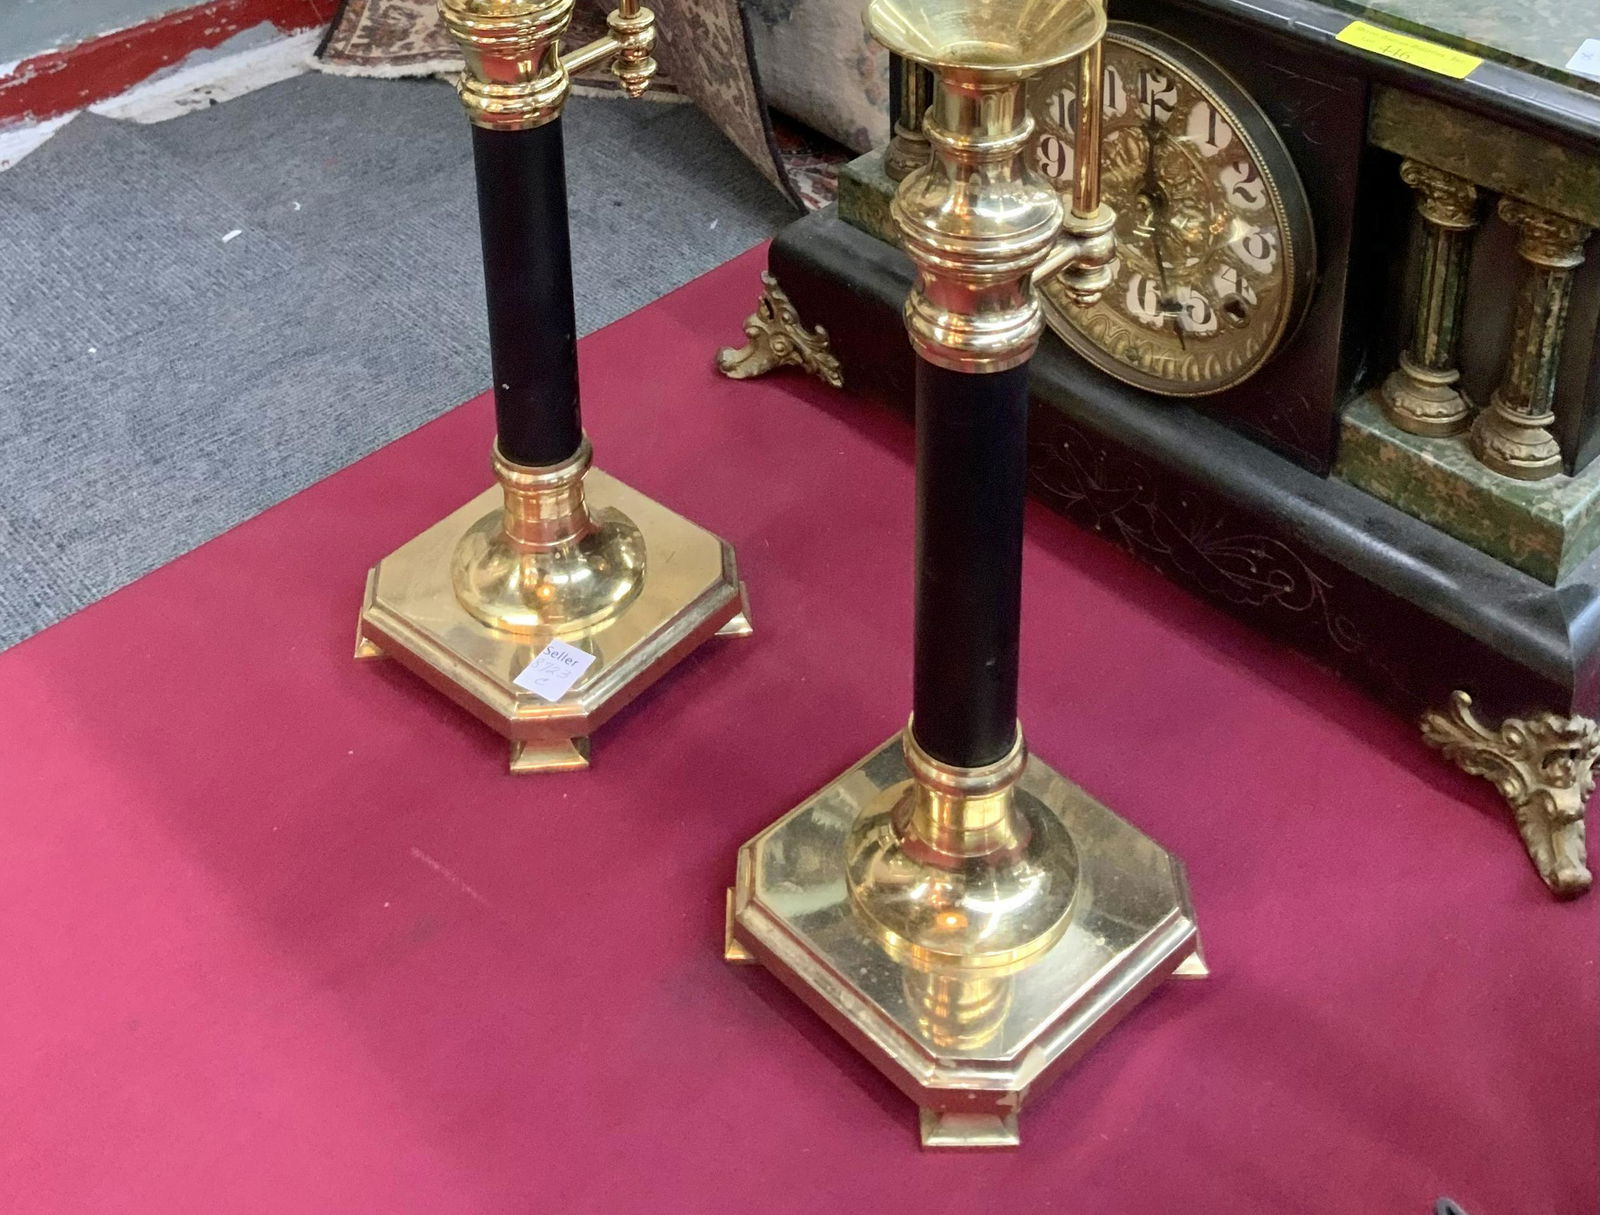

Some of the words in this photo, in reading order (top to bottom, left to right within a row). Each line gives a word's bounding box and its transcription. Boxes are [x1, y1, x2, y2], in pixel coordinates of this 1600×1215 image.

[1139, 67, 1175, 112] 12
[1206, 107, 1219, 149] 1
[1040, 136, 1066, 178] 9
[1232, 159, 1259, 204] 2
[1186, 285, 1212, 325] 5
[543, 646, 579, 667] Seller
